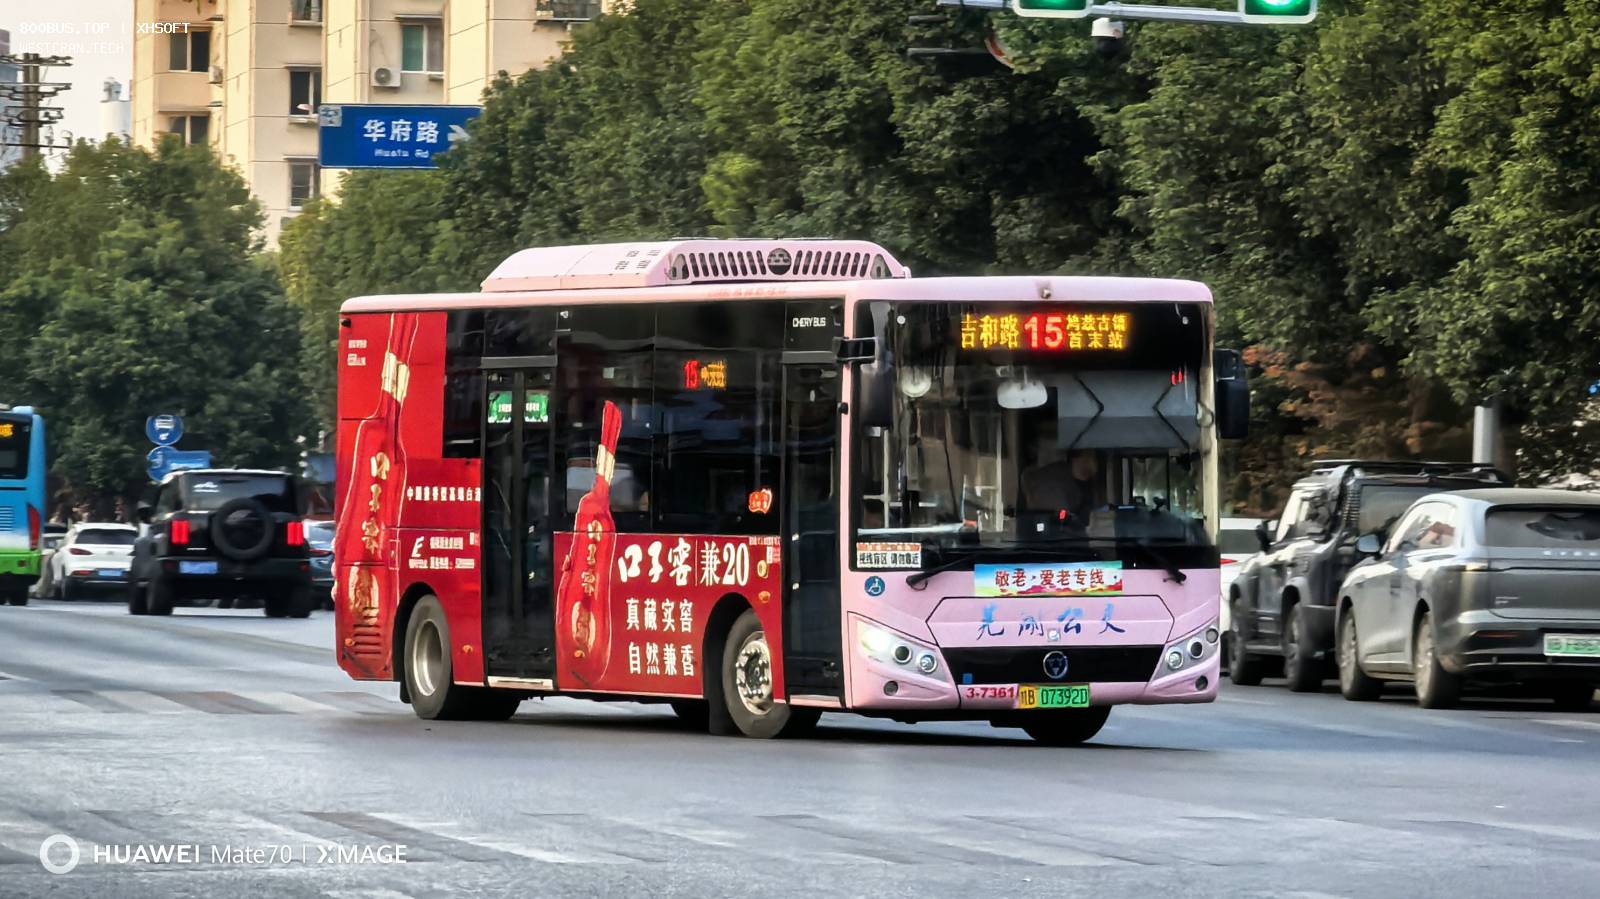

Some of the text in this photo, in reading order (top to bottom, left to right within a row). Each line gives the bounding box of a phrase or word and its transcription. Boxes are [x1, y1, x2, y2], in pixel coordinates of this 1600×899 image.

[363, 119, 439, 143] 华府路
[960, 314, 1019, 349] 吉和路
[1024, 315, 1064, 349] 15
[1068, 332, 1124, 349] 首末站
[617, 537, 749, 587] 口子窖 兼20
[625, 597, 693, 633] 真藏实窖
[628, 642, 695, 677] 自然兼香
